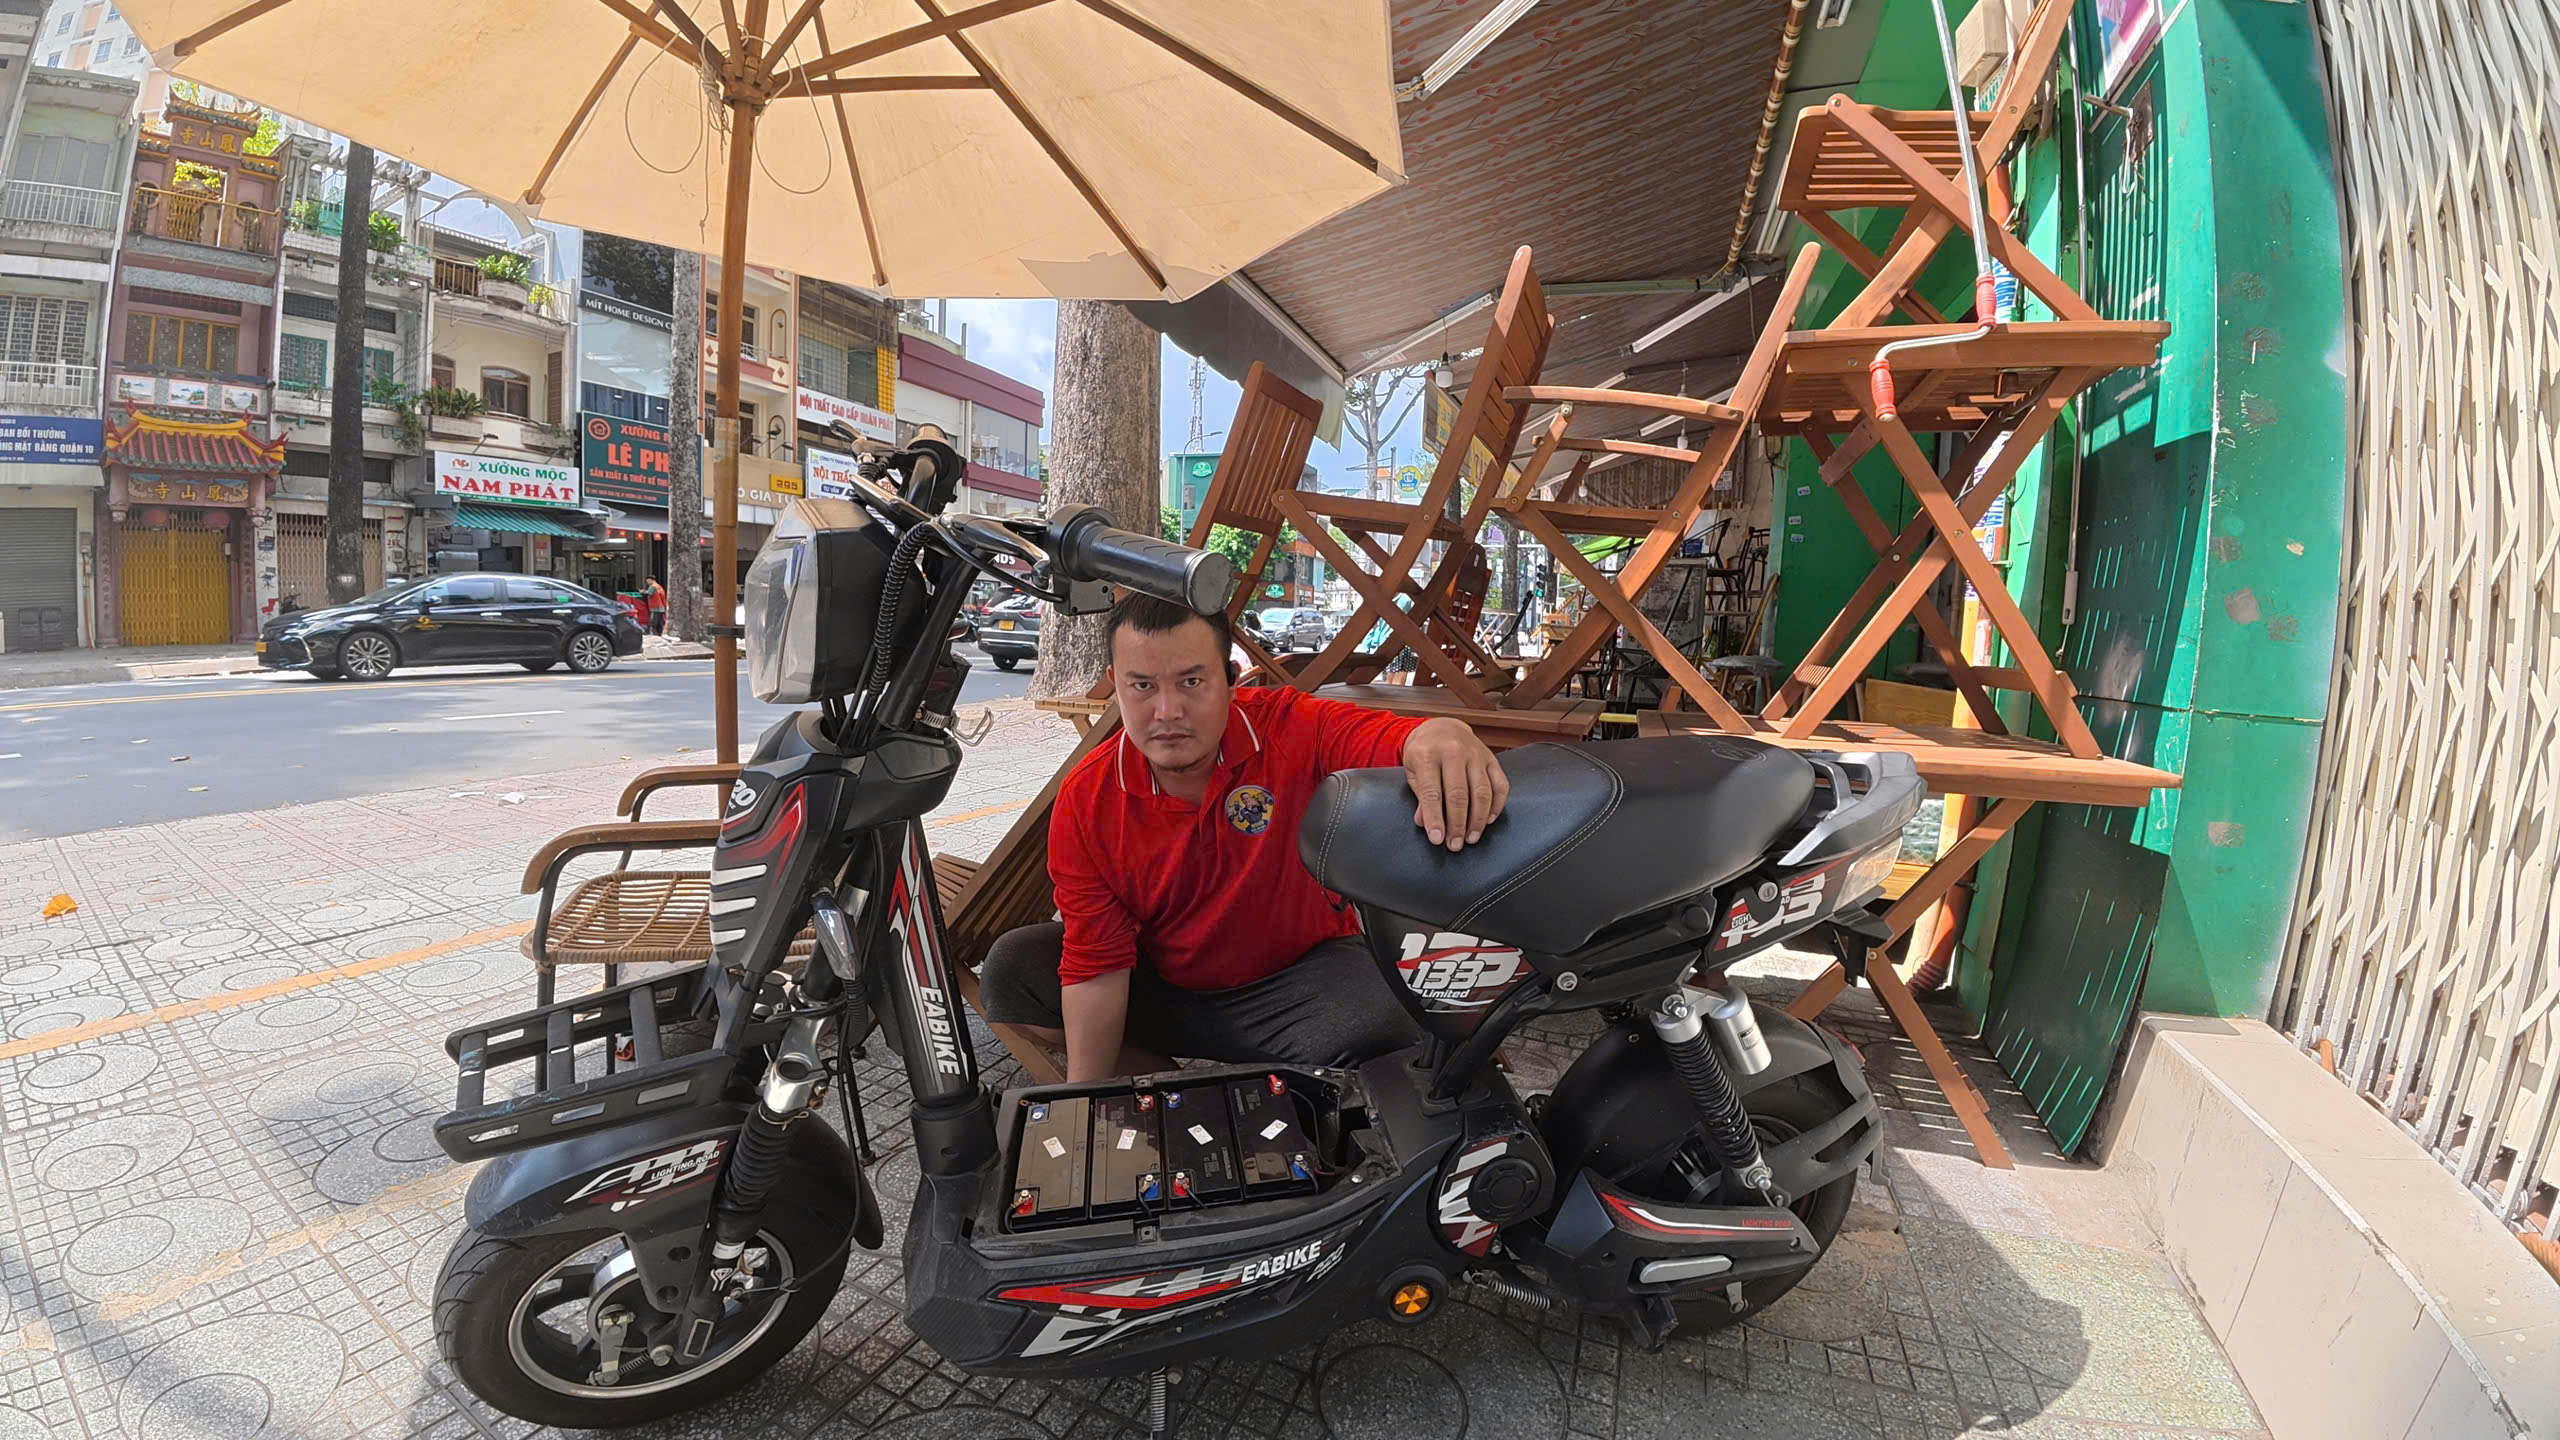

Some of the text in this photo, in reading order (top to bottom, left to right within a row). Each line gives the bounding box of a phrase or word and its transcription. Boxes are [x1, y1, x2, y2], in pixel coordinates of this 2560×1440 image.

[585, 298, 603, 310] MÍT
[604, 304, 631, 318] HOME
[632, 312, 664, 328] DESIGN
[799, 392, 813, 410] NỘI
[813, 397, 831, 414] THẤT
[831, 403, 845, 418] CAO
[846, 405, 859, 422] CẤP
[607, 442, 633, 468] LÊ
[477, 460, 530, 477] XƯỞNG
[535, 468, 568, 482] MỘC
[812, 464, 829, 481] NỘI
[441, 474, 502, 495] NAM
[508, 482, 574, 501] PHÁT
[750, 489, 772, 503] GIA
[1412, 960, 1486, 990] 133
[1422, 989, 1471, 999] Limited
[919, 986, 961, 1075] EABIKE
[650, 1150, 720, 1181] LIGHTING ROAD
[1240, 1240, 1323, 1284] EABIKE
